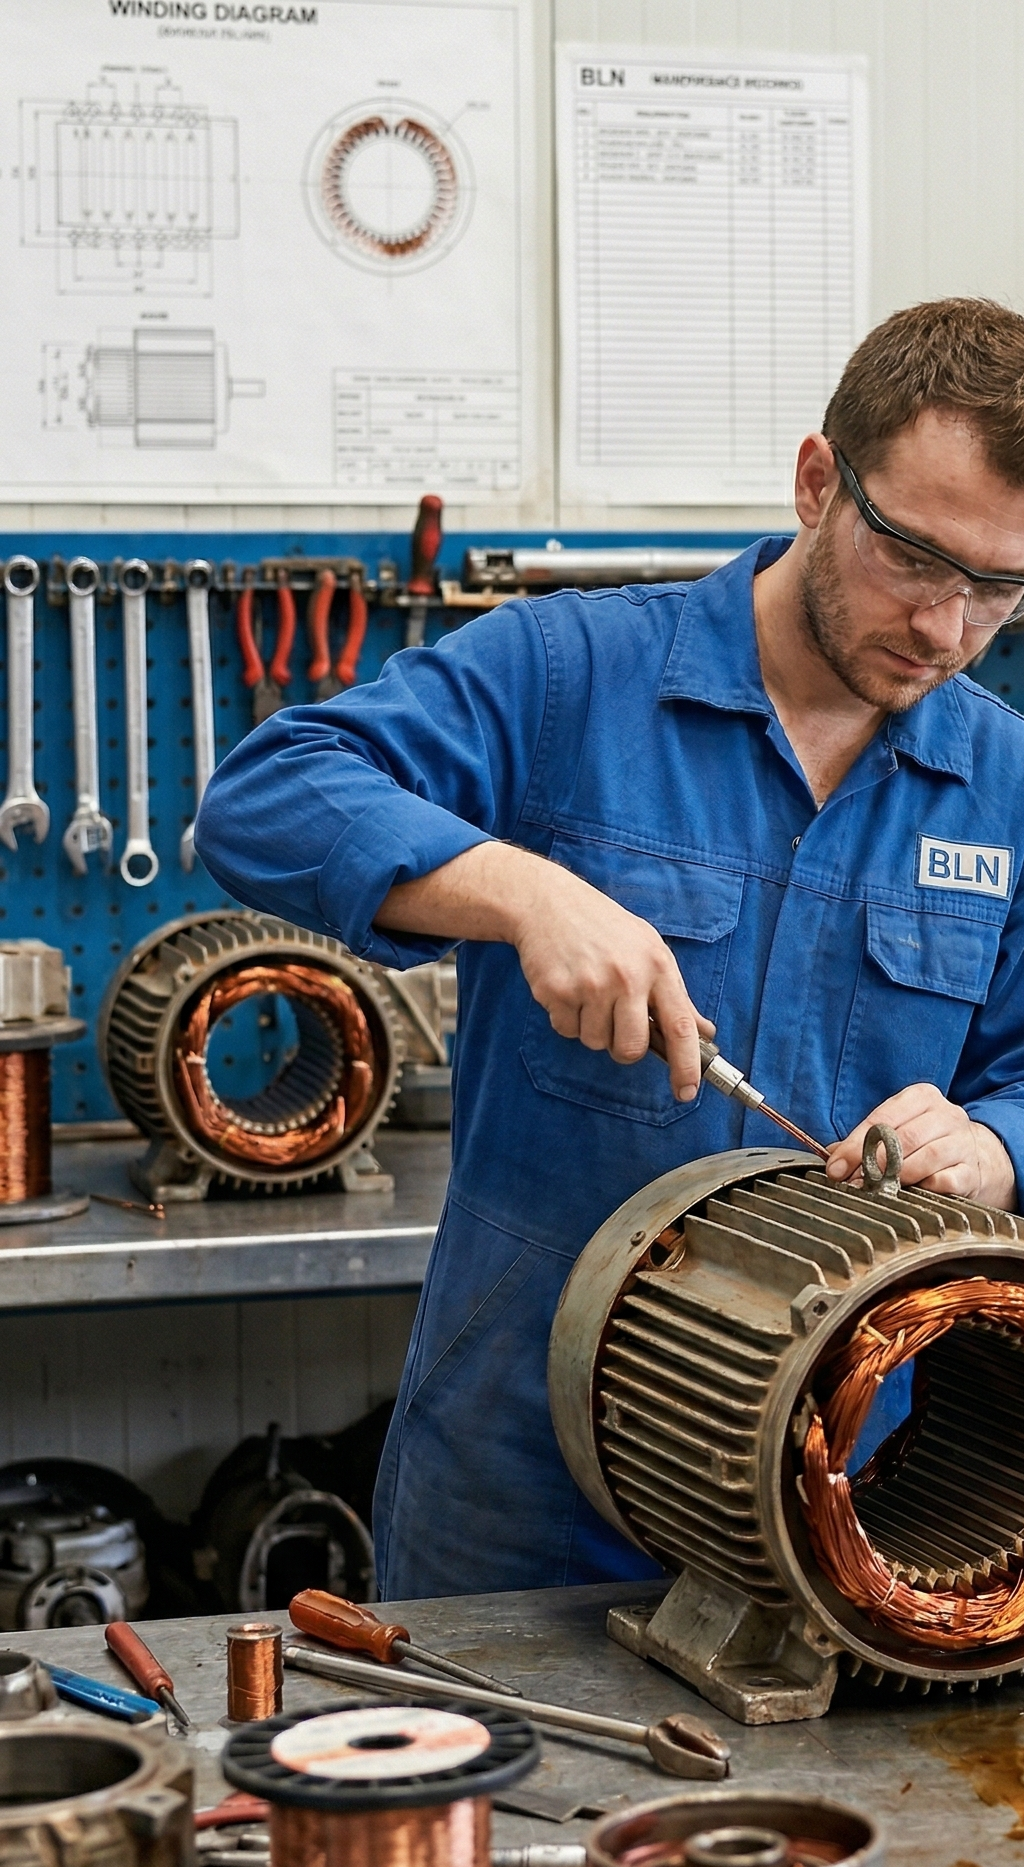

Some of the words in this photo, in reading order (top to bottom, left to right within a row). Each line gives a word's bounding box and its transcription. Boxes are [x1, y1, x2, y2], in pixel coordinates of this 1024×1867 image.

[109, 0, 207, 20] WINDING
[214, 3, 319, 25] DIAGRAM
[580, 67, 626, 88] BLN
[928, 847, 1000, 886] BLN
